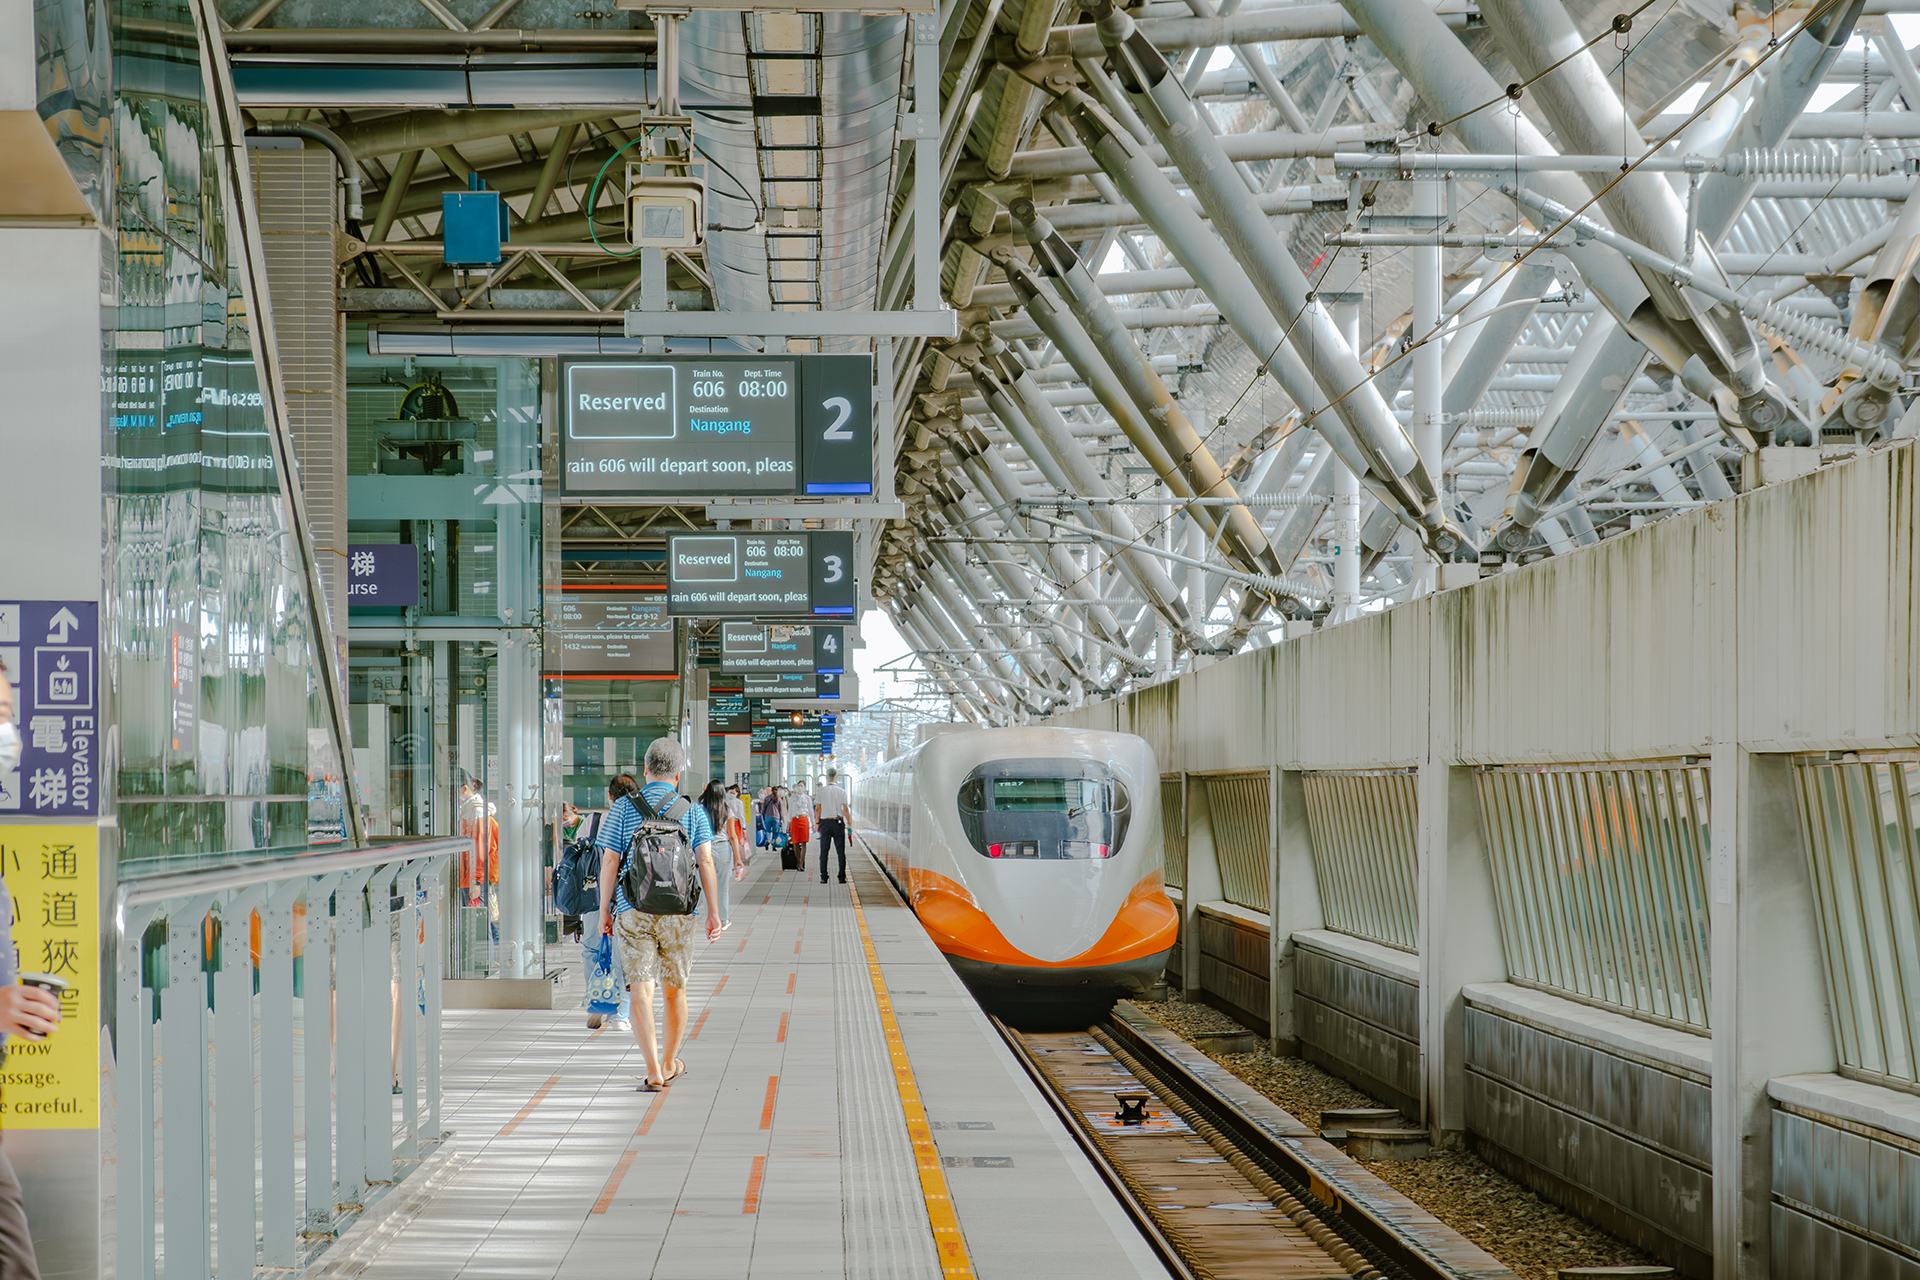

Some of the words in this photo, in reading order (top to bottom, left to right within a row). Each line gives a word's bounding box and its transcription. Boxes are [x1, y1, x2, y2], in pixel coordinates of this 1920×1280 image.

[744, 370, 762, 379] Dept.
[693, 381, 724, 397] 606
[738, 380, 787, 397] 08:00
[579, 392, 666, 411] Reserved
[690, 418, 751, 433] Nangang
[822, 397, 853, 440] 2
[599, 459, 625, 472] 606
[630, 458, 655, 472] will
[660, 458, 708, 475] depart
[712, 461, 750, 475] soon,
[756, 457, 793, 475] pleas
[679, 553, 731, 564] Reserved
[747, 547, 766, 556] 606
[774, 546, 803, 556] 08:00
[351, 552, 375, 577] 梯
[823, 555, 842, 583] 3
[745, 569, 782, 578] Nangang
[691, 593, 707, 602] 606
[709, 592, 725, 602] will
[727, 592, 756, 603] depart
[759, 594, 782, 603] soon,
[784, 592, 808, 603] pleas
[728, 633, 763, 641] Reserved
[823, 634, 837, 654] 4
[29, 715, 68, 809] 電梯
[72, 716, 94, 810] Elevator
[15, 1097, 82, 1114] careful.
